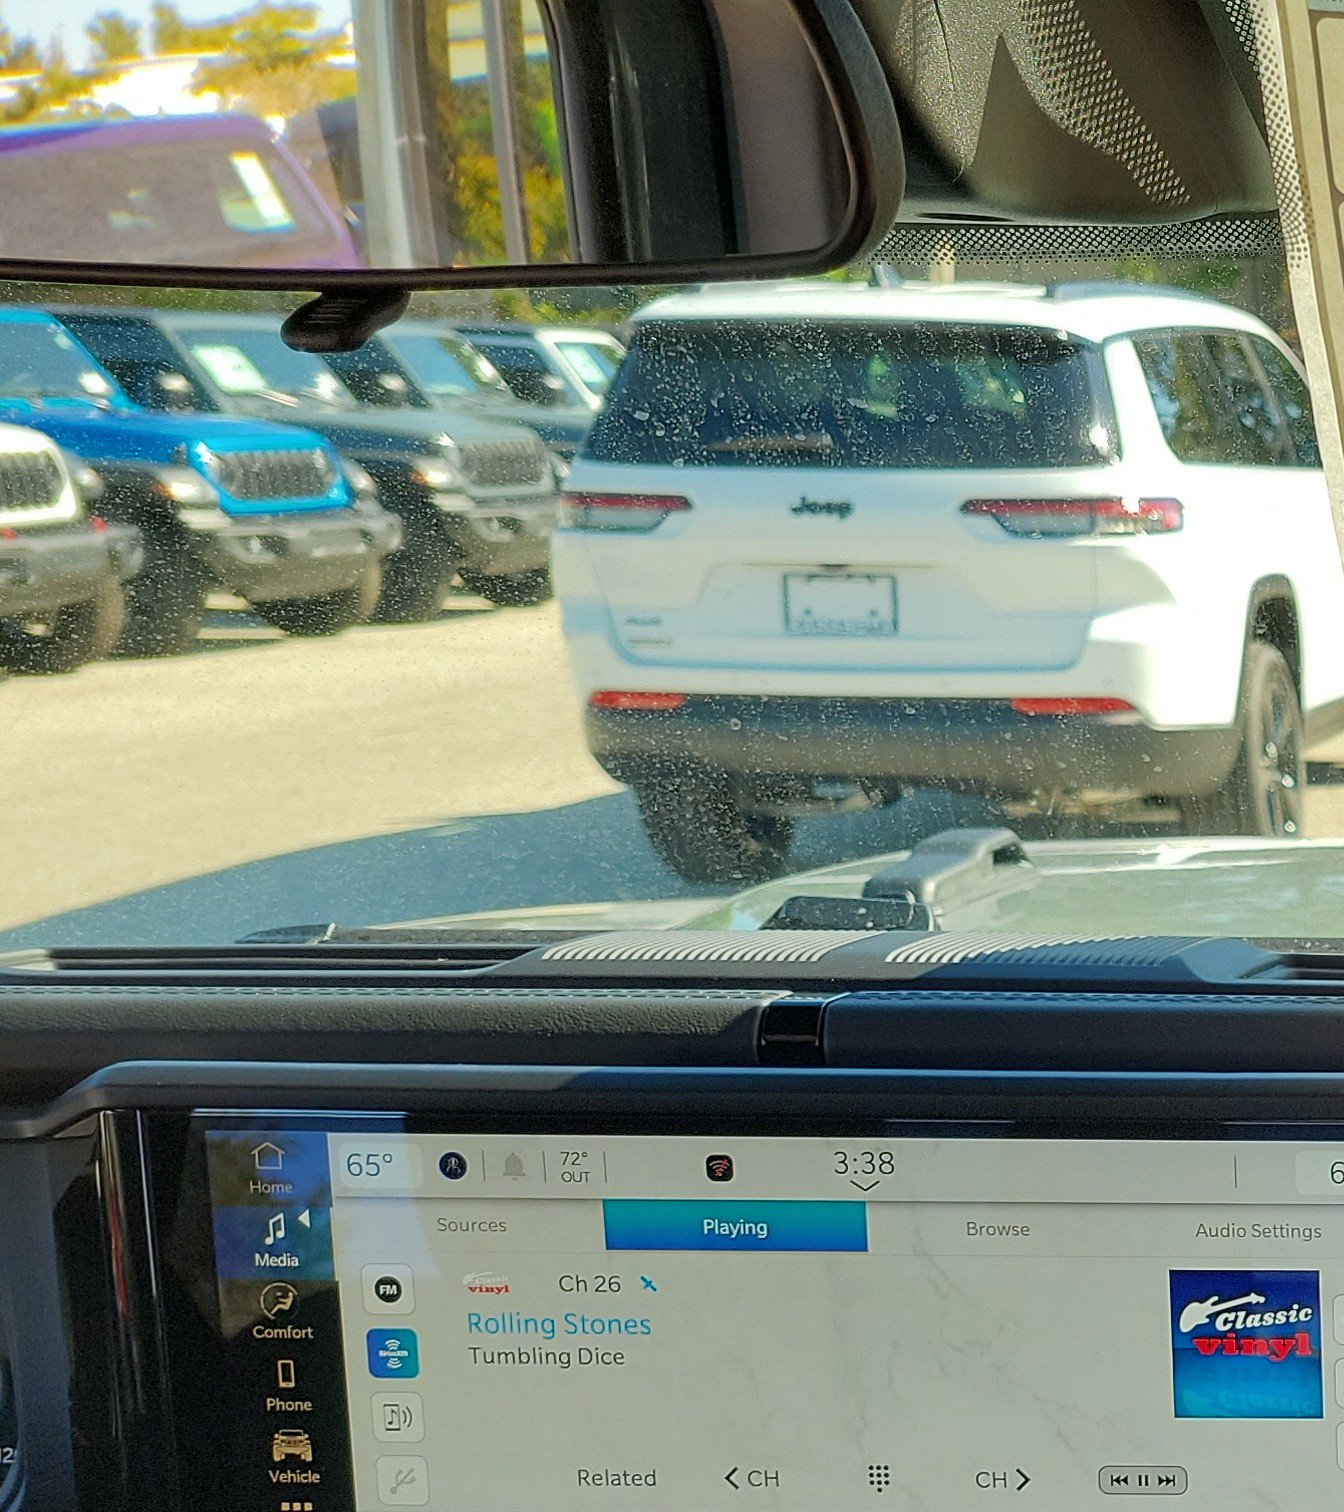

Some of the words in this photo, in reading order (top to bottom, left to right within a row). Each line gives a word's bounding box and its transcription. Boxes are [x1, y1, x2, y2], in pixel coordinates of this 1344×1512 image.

[790, 497, 853, 518] Jeep
[346, 1152, 393, 1177] 65°
[560, 1151, 588, 1166] 72°
[834, 1151, 895, 1176] 3:38
[250, 1179, 293, 1194] Home
[561, 1171, 590, 1183] OUT
[437, 1217, 507, 1233] Sources
[703, 1218, 768, 1239] Playing
[966, 1221, 1030, 1236] Browse
[1195, 1223, 1246, 1239] Audio
[1251, 1223, 1322, 1241] Settings
[254, 1253, 299, 1267] Media
[378, 1283, 398, 1296] FM
[559, 1274, 588, 1293] Ch
[595, 1275, 621, 1293] 26
[468, 1312, 556, 1339] Rolling
[564, 1313, 651, 1335] Stones
[1214, 1303, 1313, 1333] Classic
[252, 1324, 313, 1340] Comfort
[469, 1347, 572, 1369] Tumbling
[579, 1347, 625, 1366] Dice
[1192, 1333, 1312, 1362] vinyl
[266, 1397, 312, 1412] Phone
[268, 1468, 321, 1483] Vehicle
[577, 1468, 657, 1486] Related
[747, 1470, 779, 1487] CH
[975, 1471, 1008, 1488] CH
